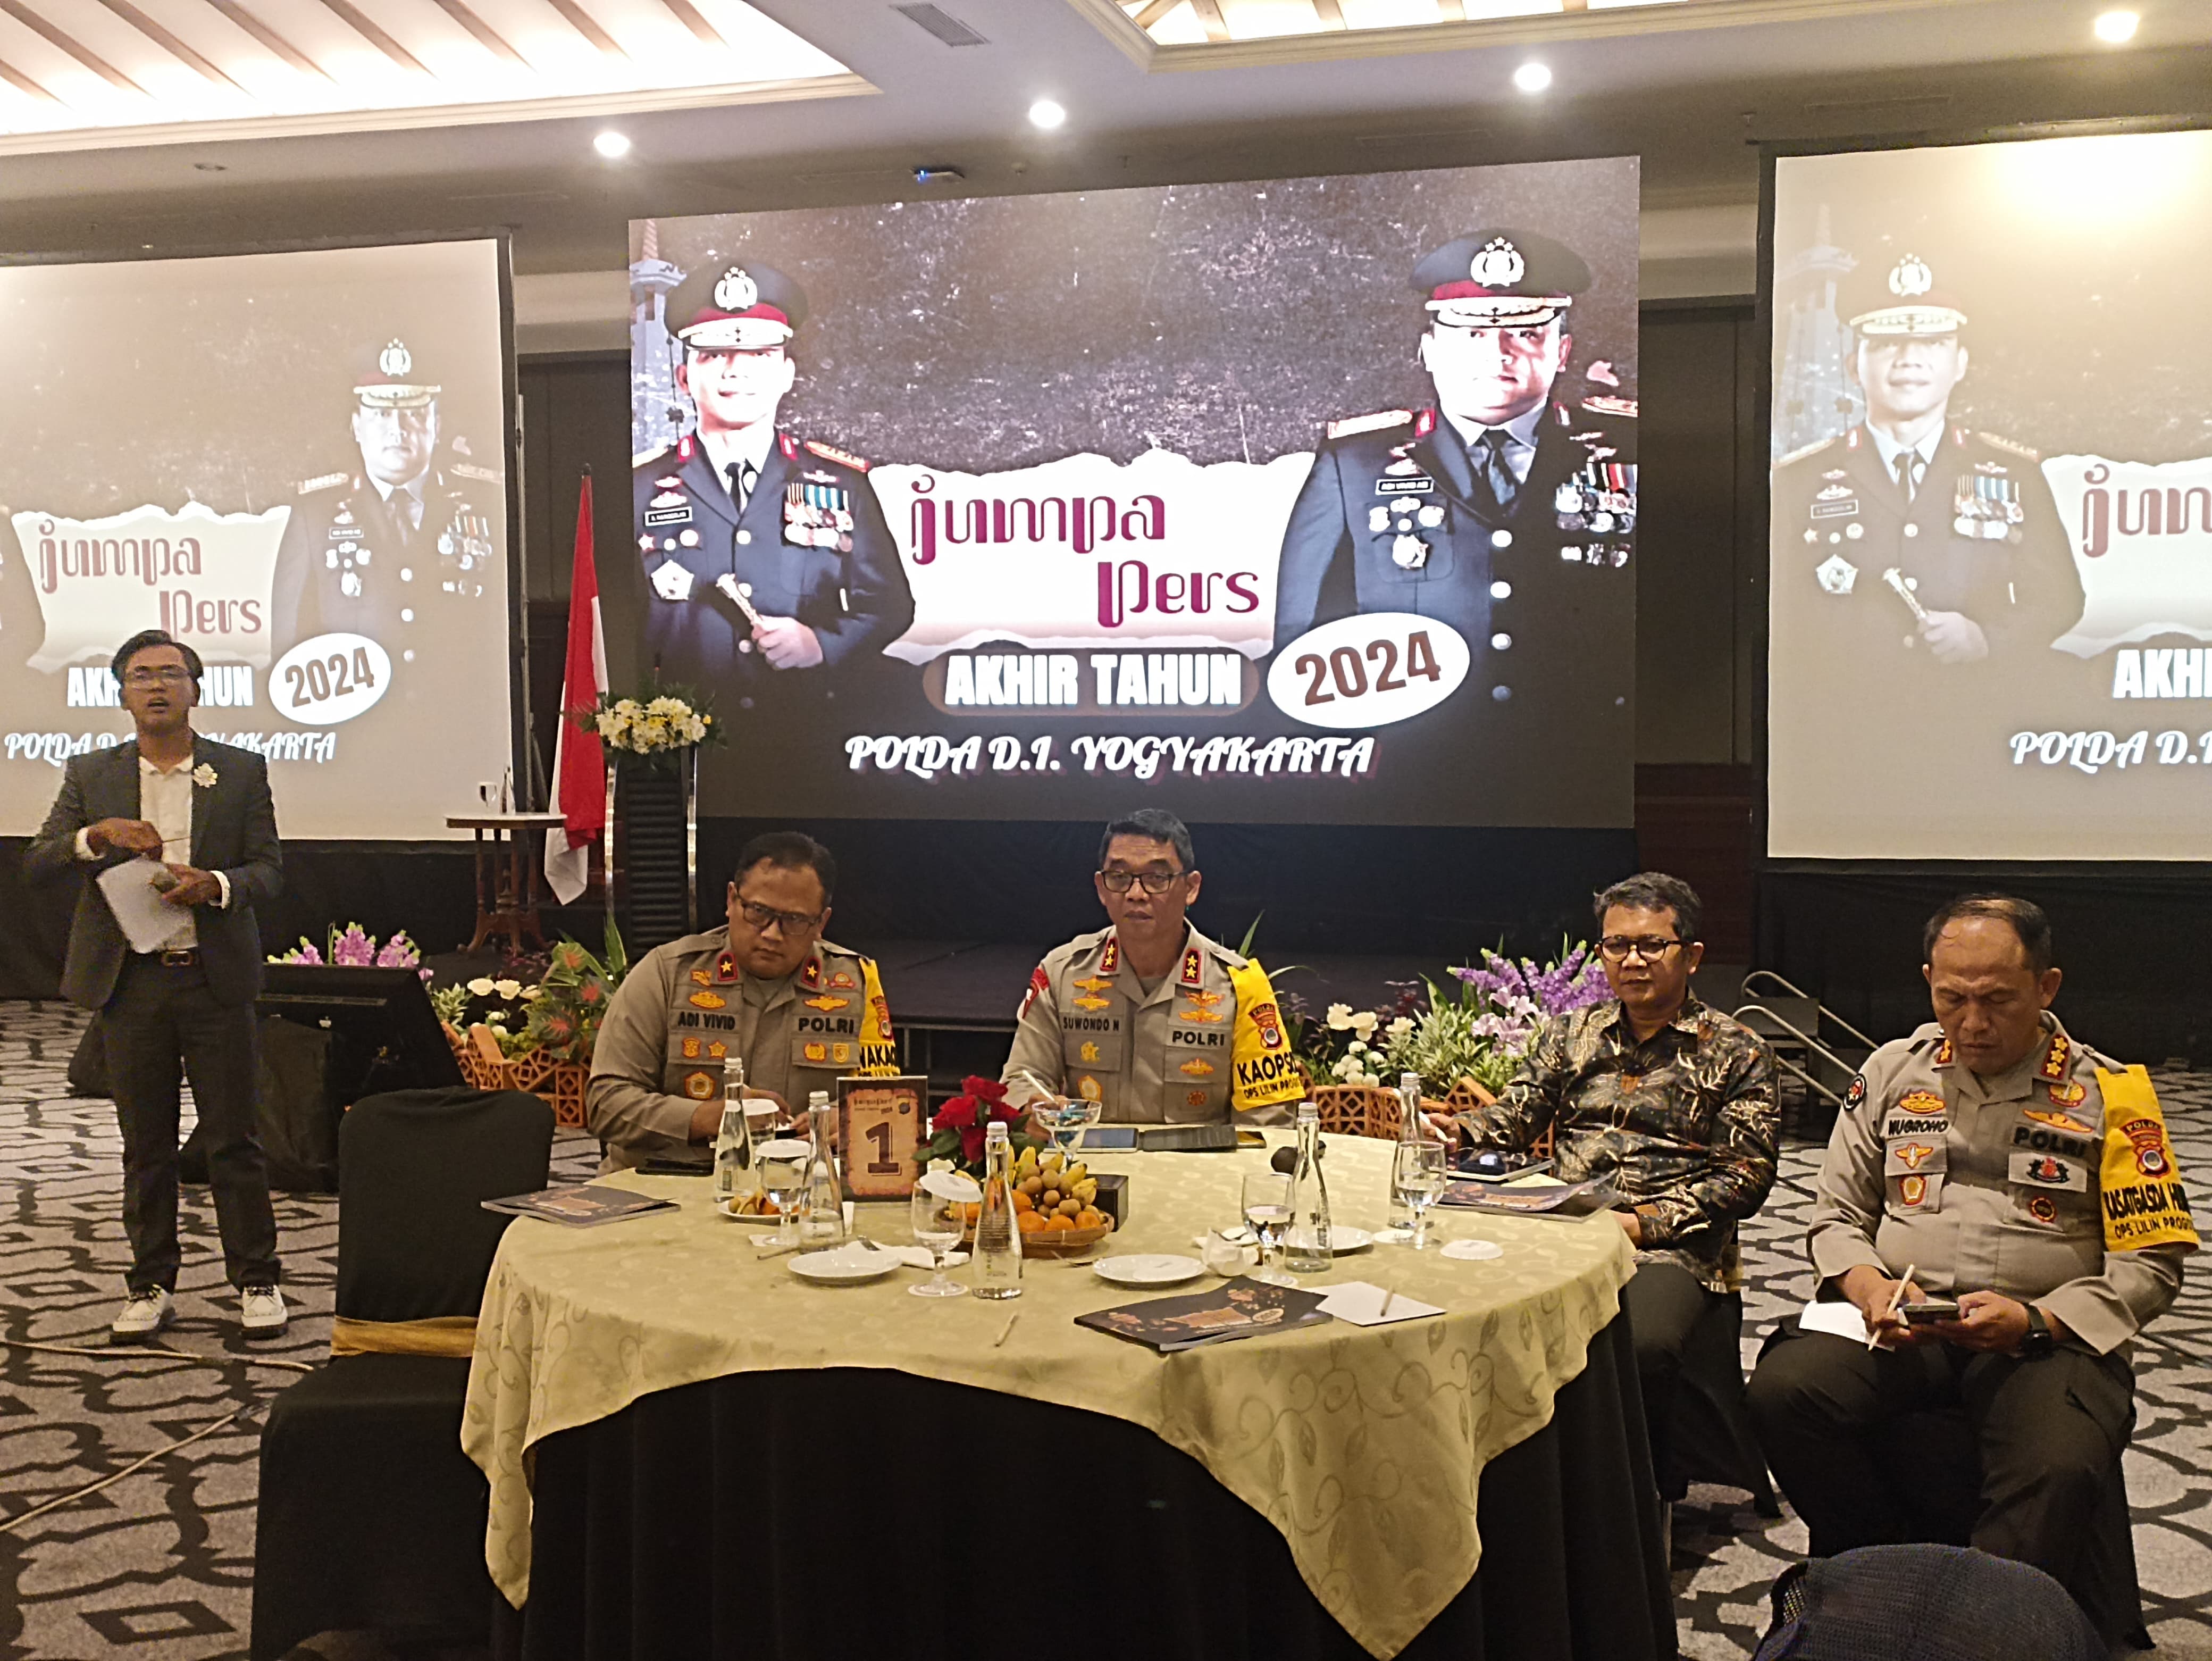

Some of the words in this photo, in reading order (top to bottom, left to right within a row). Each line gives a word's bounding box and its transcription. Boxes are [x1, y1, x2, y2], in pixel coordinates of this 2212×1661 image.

[2083, 463, 2212, 558] jum
[67, 667, 122, 707] AKH
[196, 666, 254, 707] HUN
[284, 646, 374, 708] 2024
[945, 655, 1078, 706] AKHIR
[1090, 654, 1241, 705] TAHUN
[1295, 630, 1442, 706] 2024
[845, 735, 982, 779] POLDA
[988, 736, 1061, 771] D.I.
[1070, 736, 1376, 779] YOGYAKARTA
[2010, 730, 2149, 774] POLDA
[678, 1011, 699, 1028] ADI
[703, 1013, 736, 1030] VIVID
[799, 1017, 854, 1034] POLRI
[1063, 1016, 1110, 1031] SUWONDO
[1172, 1030, 1225, 1046] POLRI
[866, 1122, 900, 1174] 1
[2013, 1126, 2087, 1157] POLRI
[2115, 1223, 2134, 1239] OPS
[2135, 1219, 2161, 1234] LILIN
